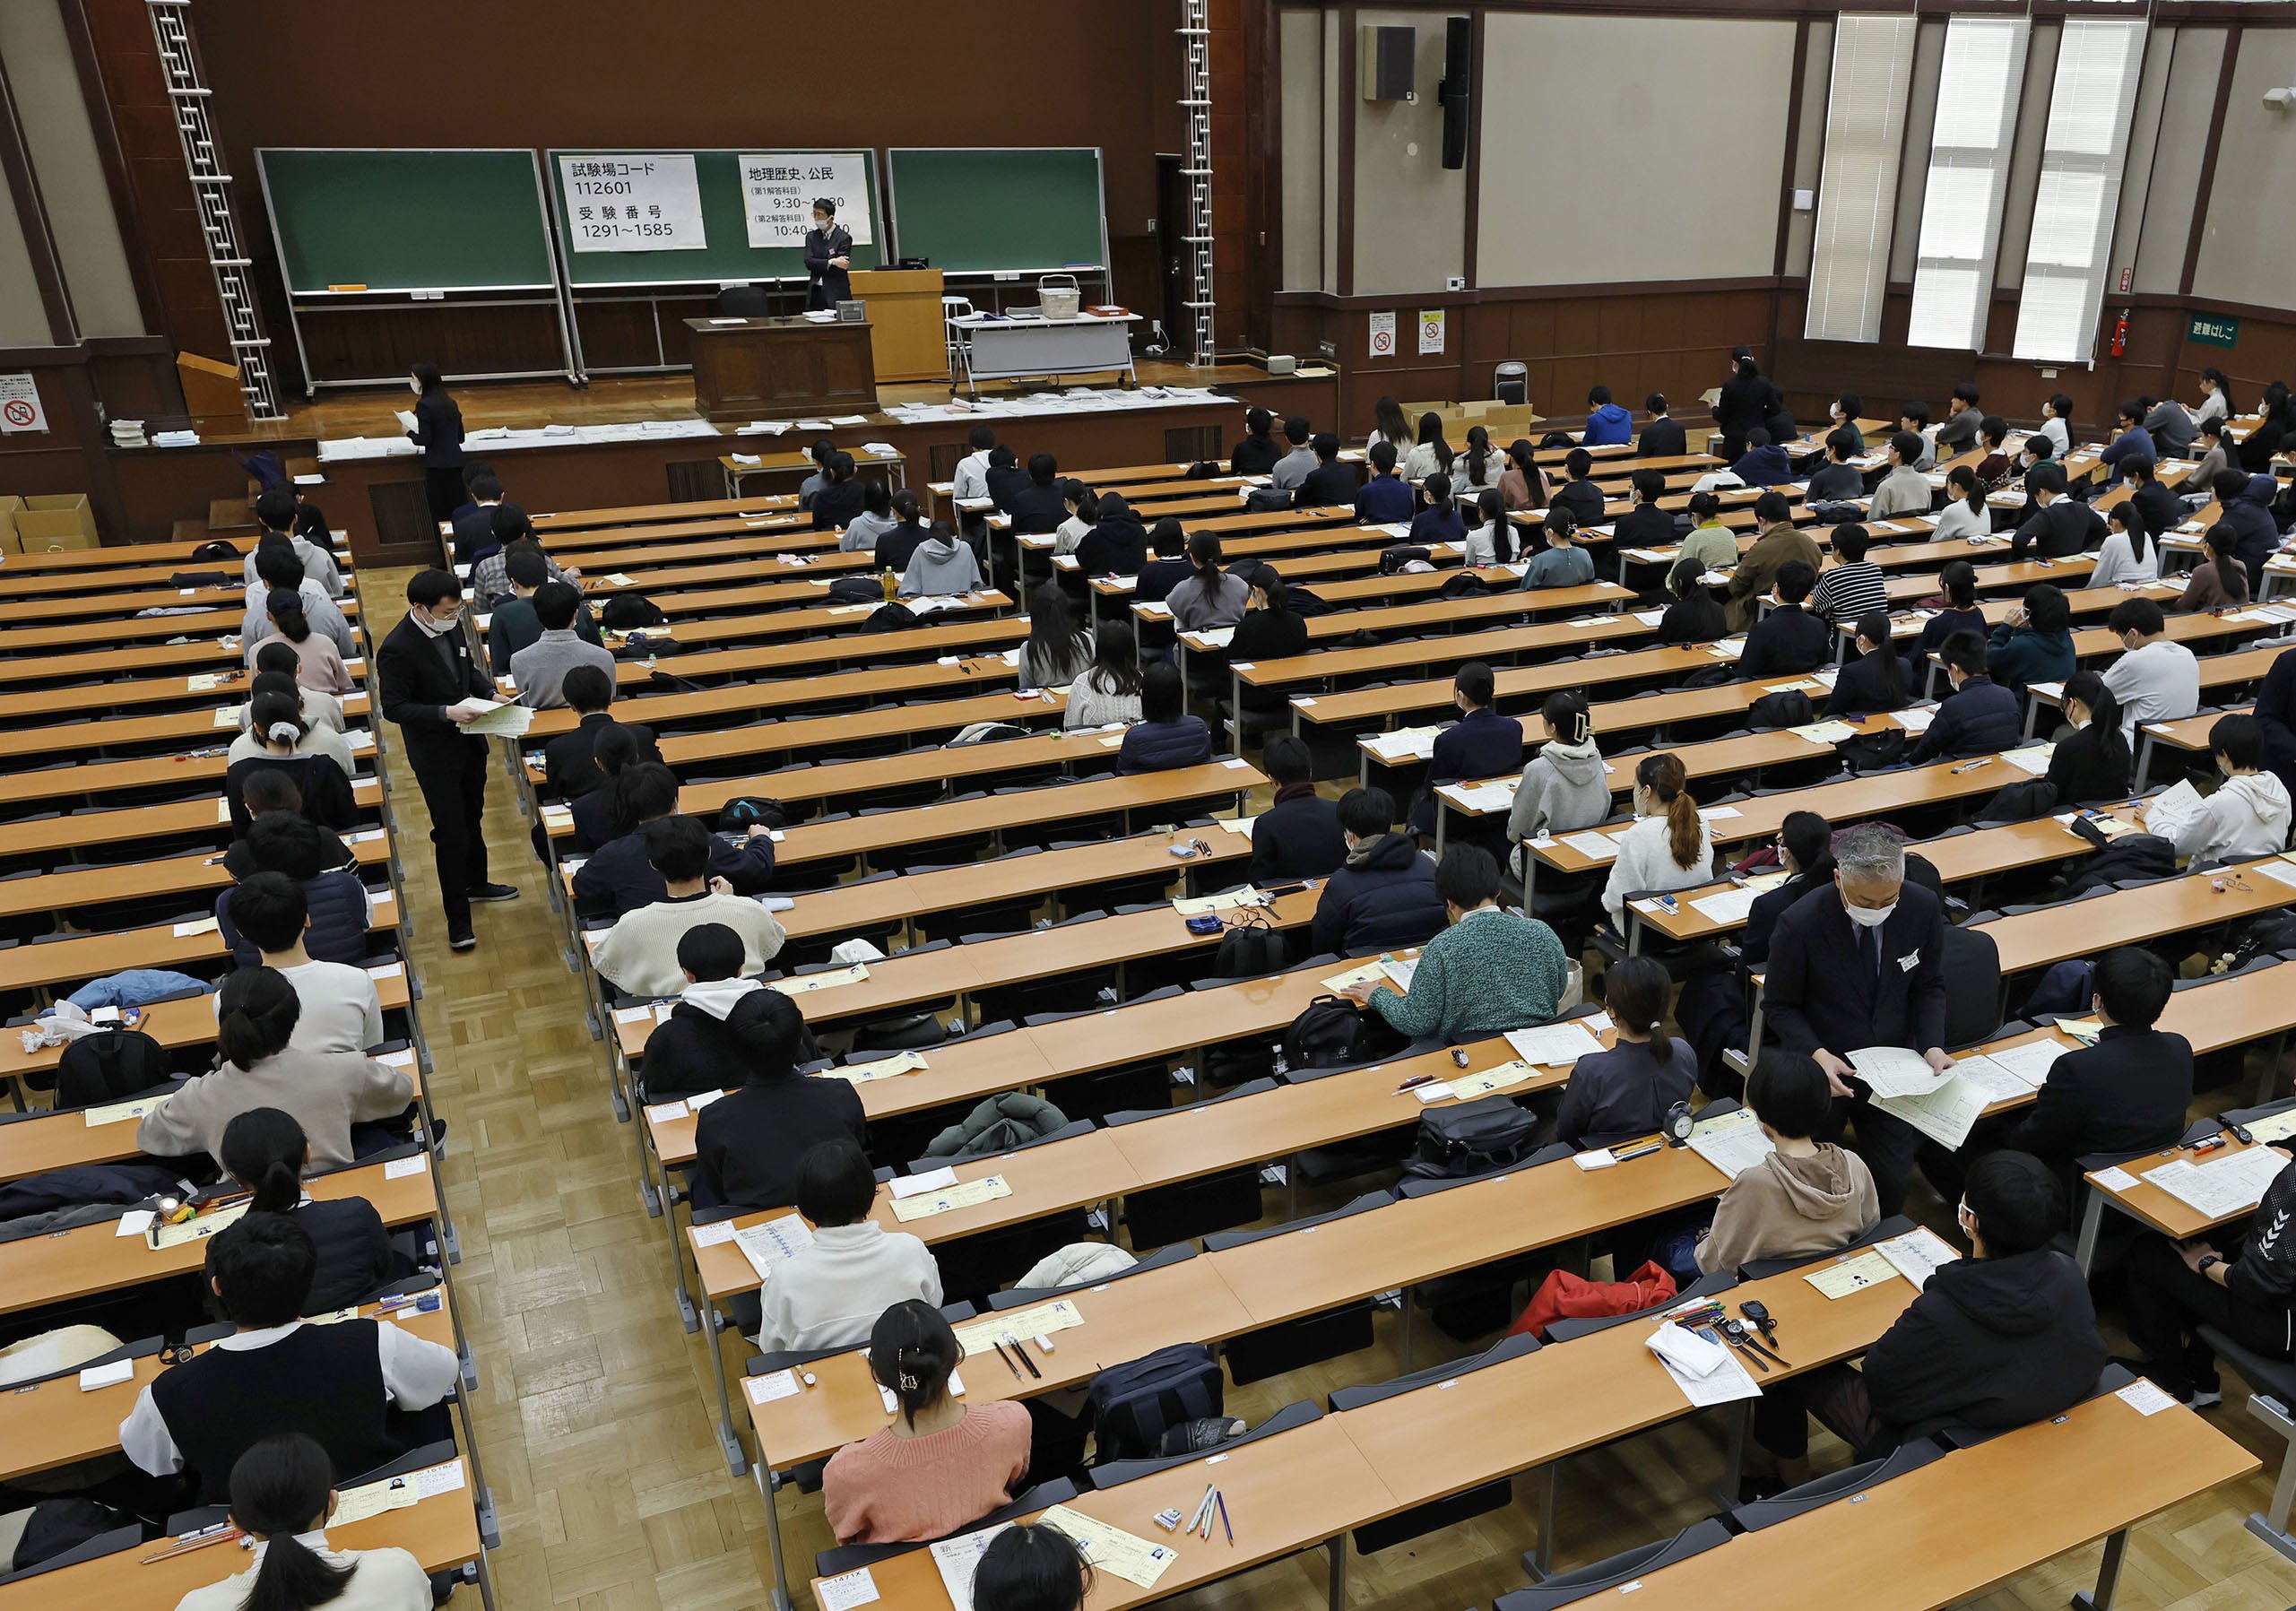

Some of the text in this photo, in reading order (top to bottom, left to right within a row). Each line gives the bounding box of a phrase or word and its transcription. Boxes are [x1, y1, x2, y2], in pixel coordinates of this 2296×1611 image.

[571, 162, 655, 178] 試験場コード
[749, 167, 834, 181] 地理歴史、公民
[575, 181, 632, 195] 112601
[2193, 321, 2234, 340] 避難はしご
